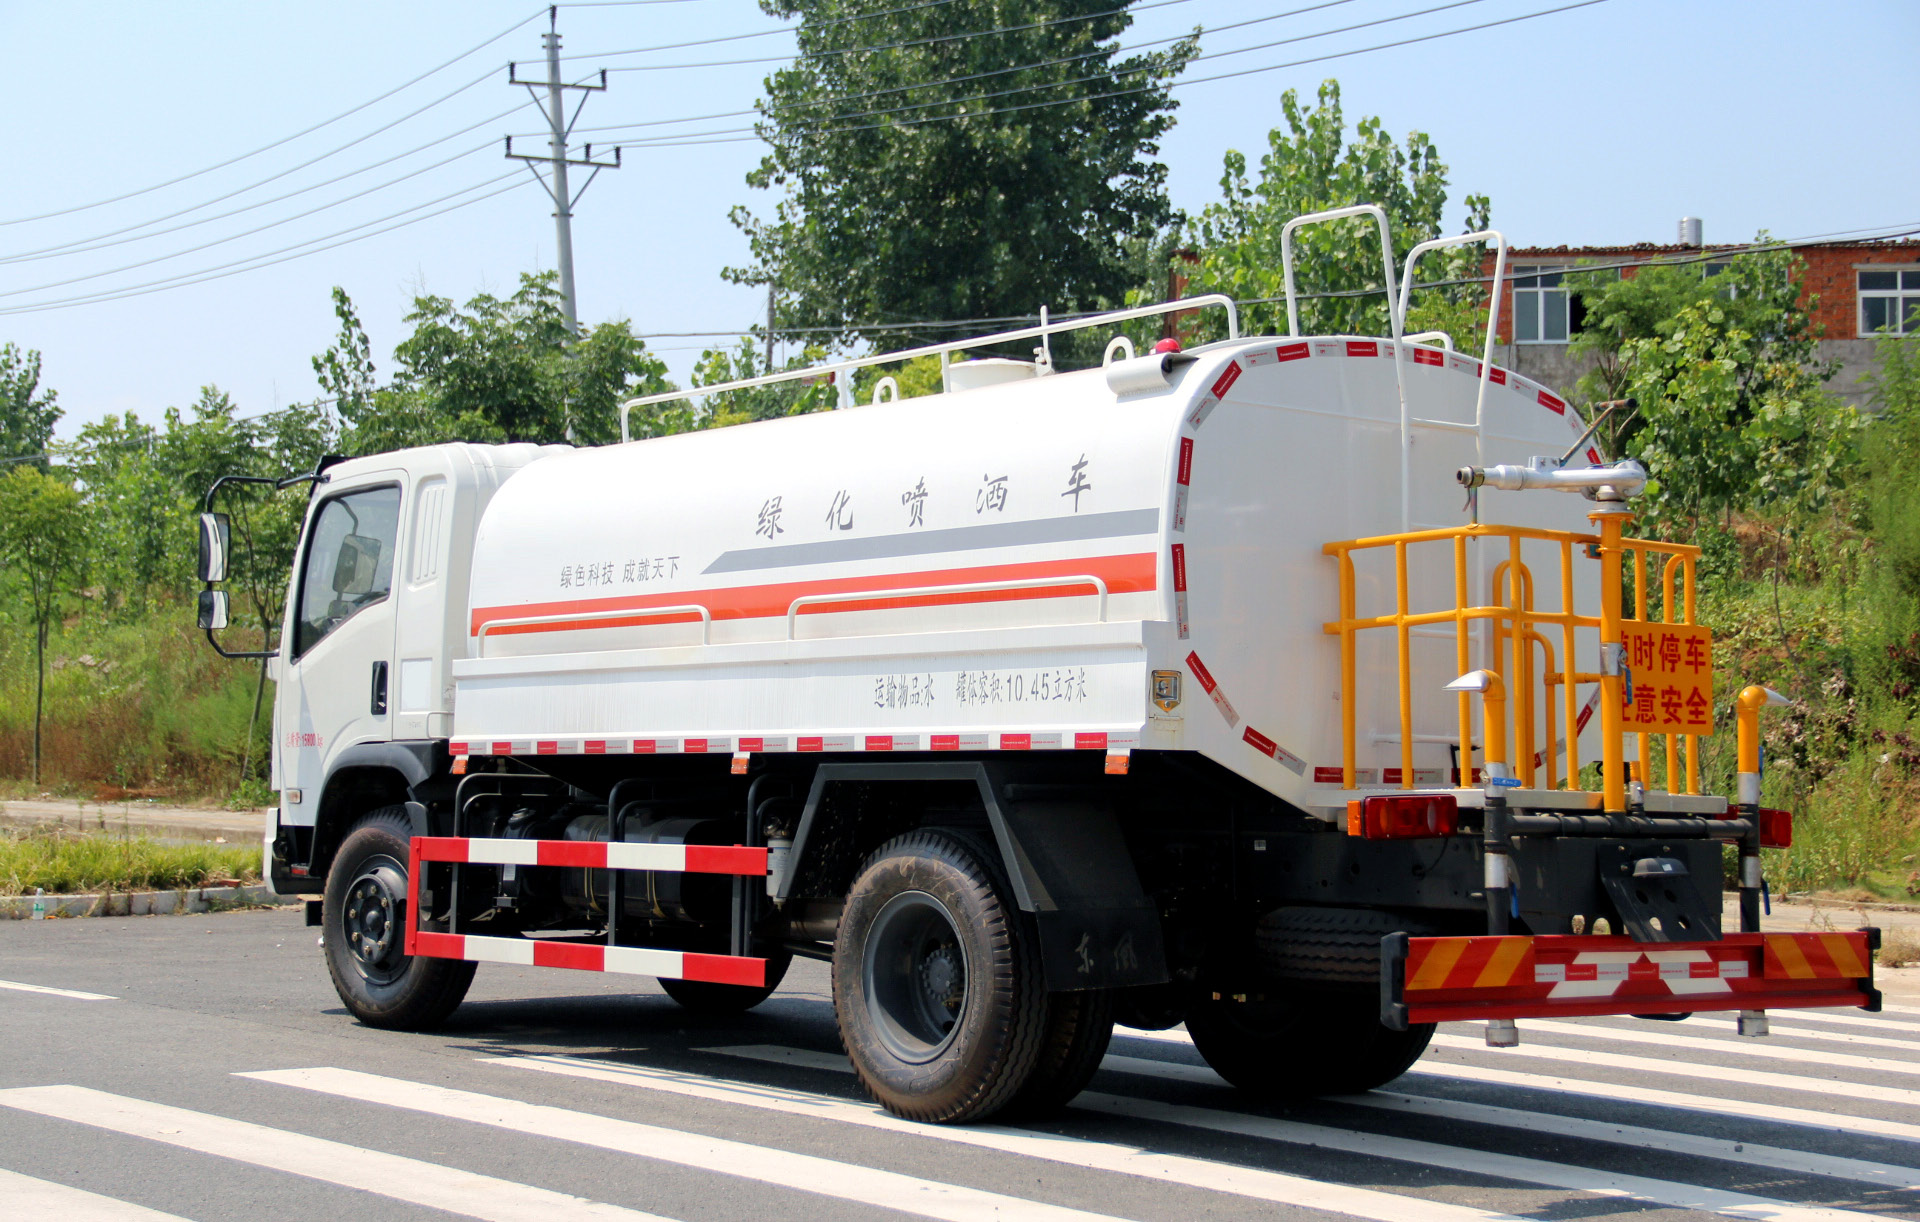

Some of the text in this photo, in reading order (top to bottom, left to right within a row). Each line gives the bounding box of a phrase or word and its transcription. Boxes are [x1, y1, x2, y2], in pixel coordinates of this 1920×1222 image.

[755, 453, 1092, 540] 绿化喷洒车
[560, 556, 680, 588] 绿色科技 成就天下
